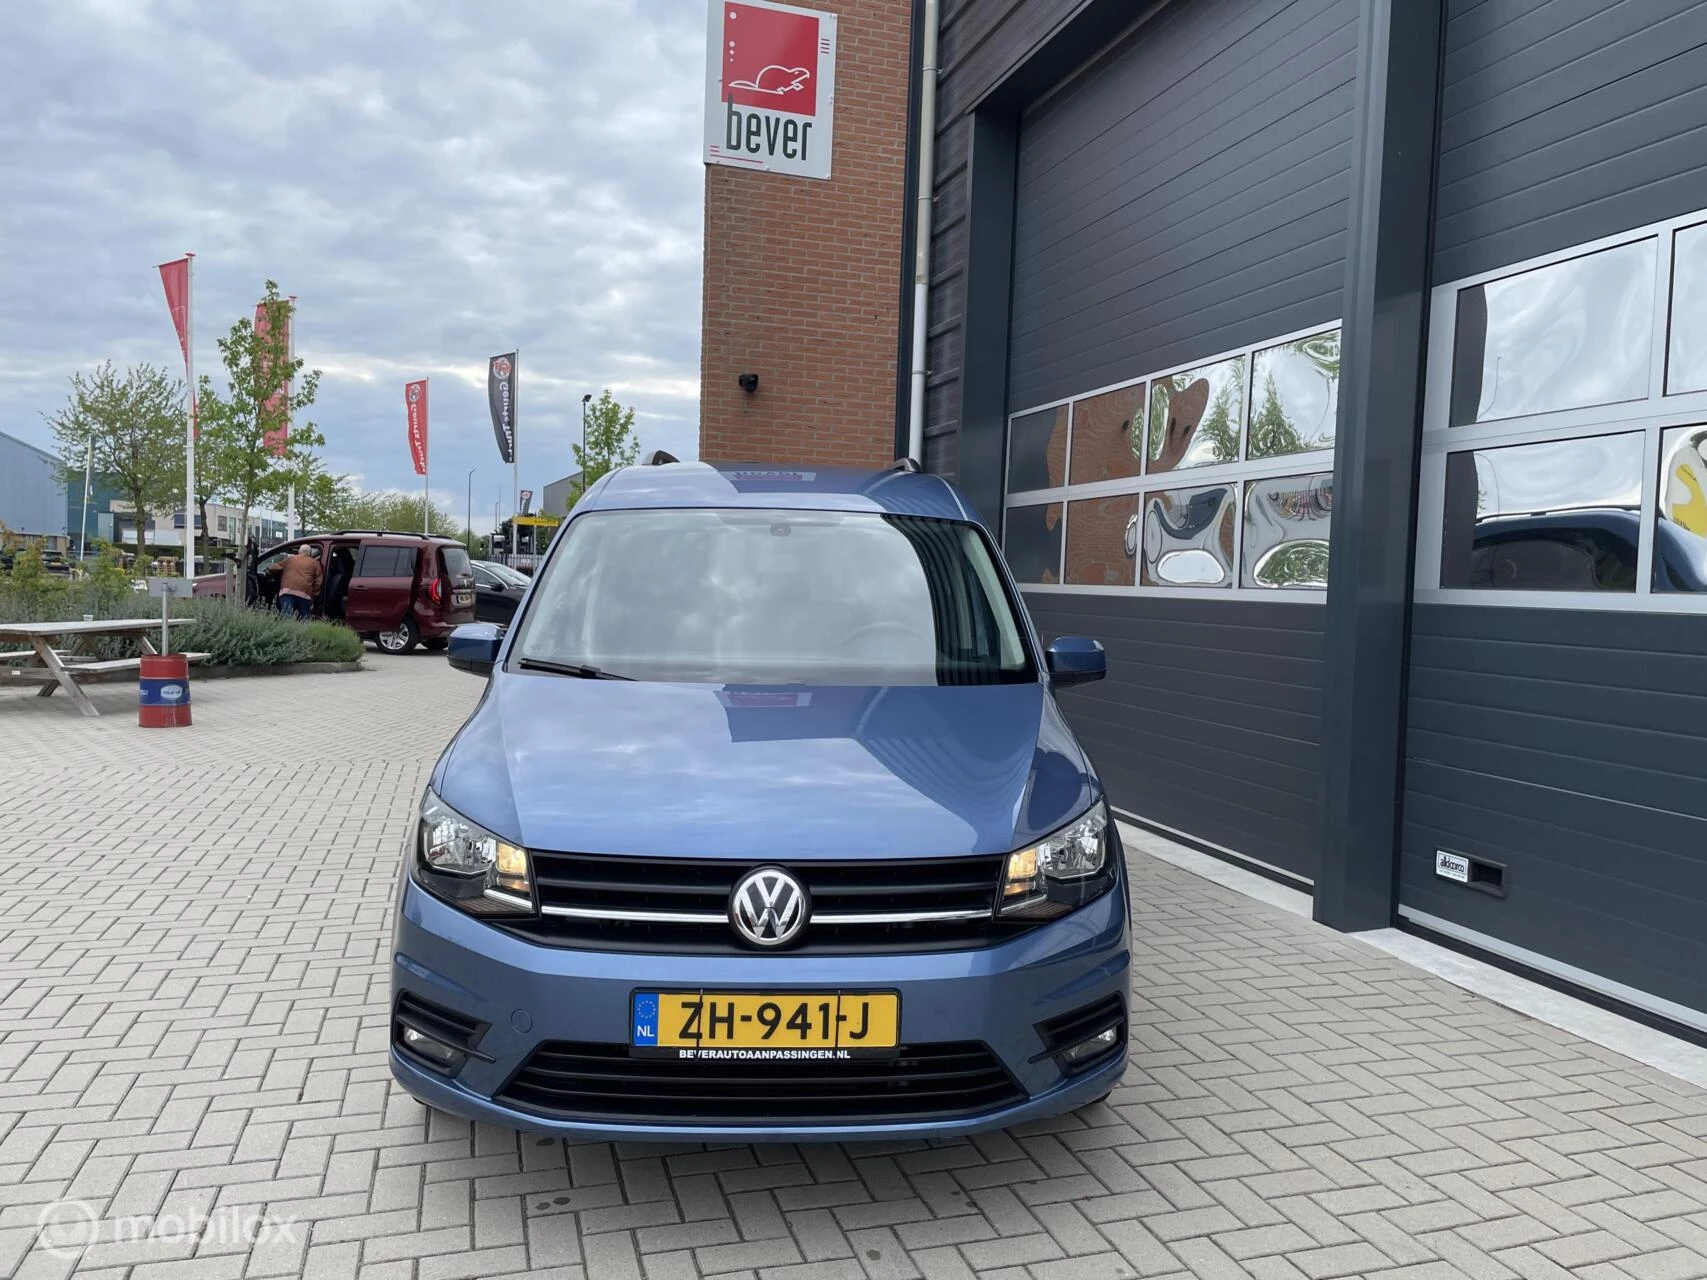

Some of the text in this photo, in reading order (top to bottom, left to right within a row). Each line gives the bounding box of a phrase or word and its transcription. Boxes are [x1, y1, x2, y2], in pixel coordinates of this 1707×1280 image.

[726, 93, 813, 161] bever
[637, 1025, 655, 1037] NL
[679, 1001, 870, 1041] ZH-941-J
[678, 1049, 851, 1060] BEVERAUTOAANPASSINGEN.NL
